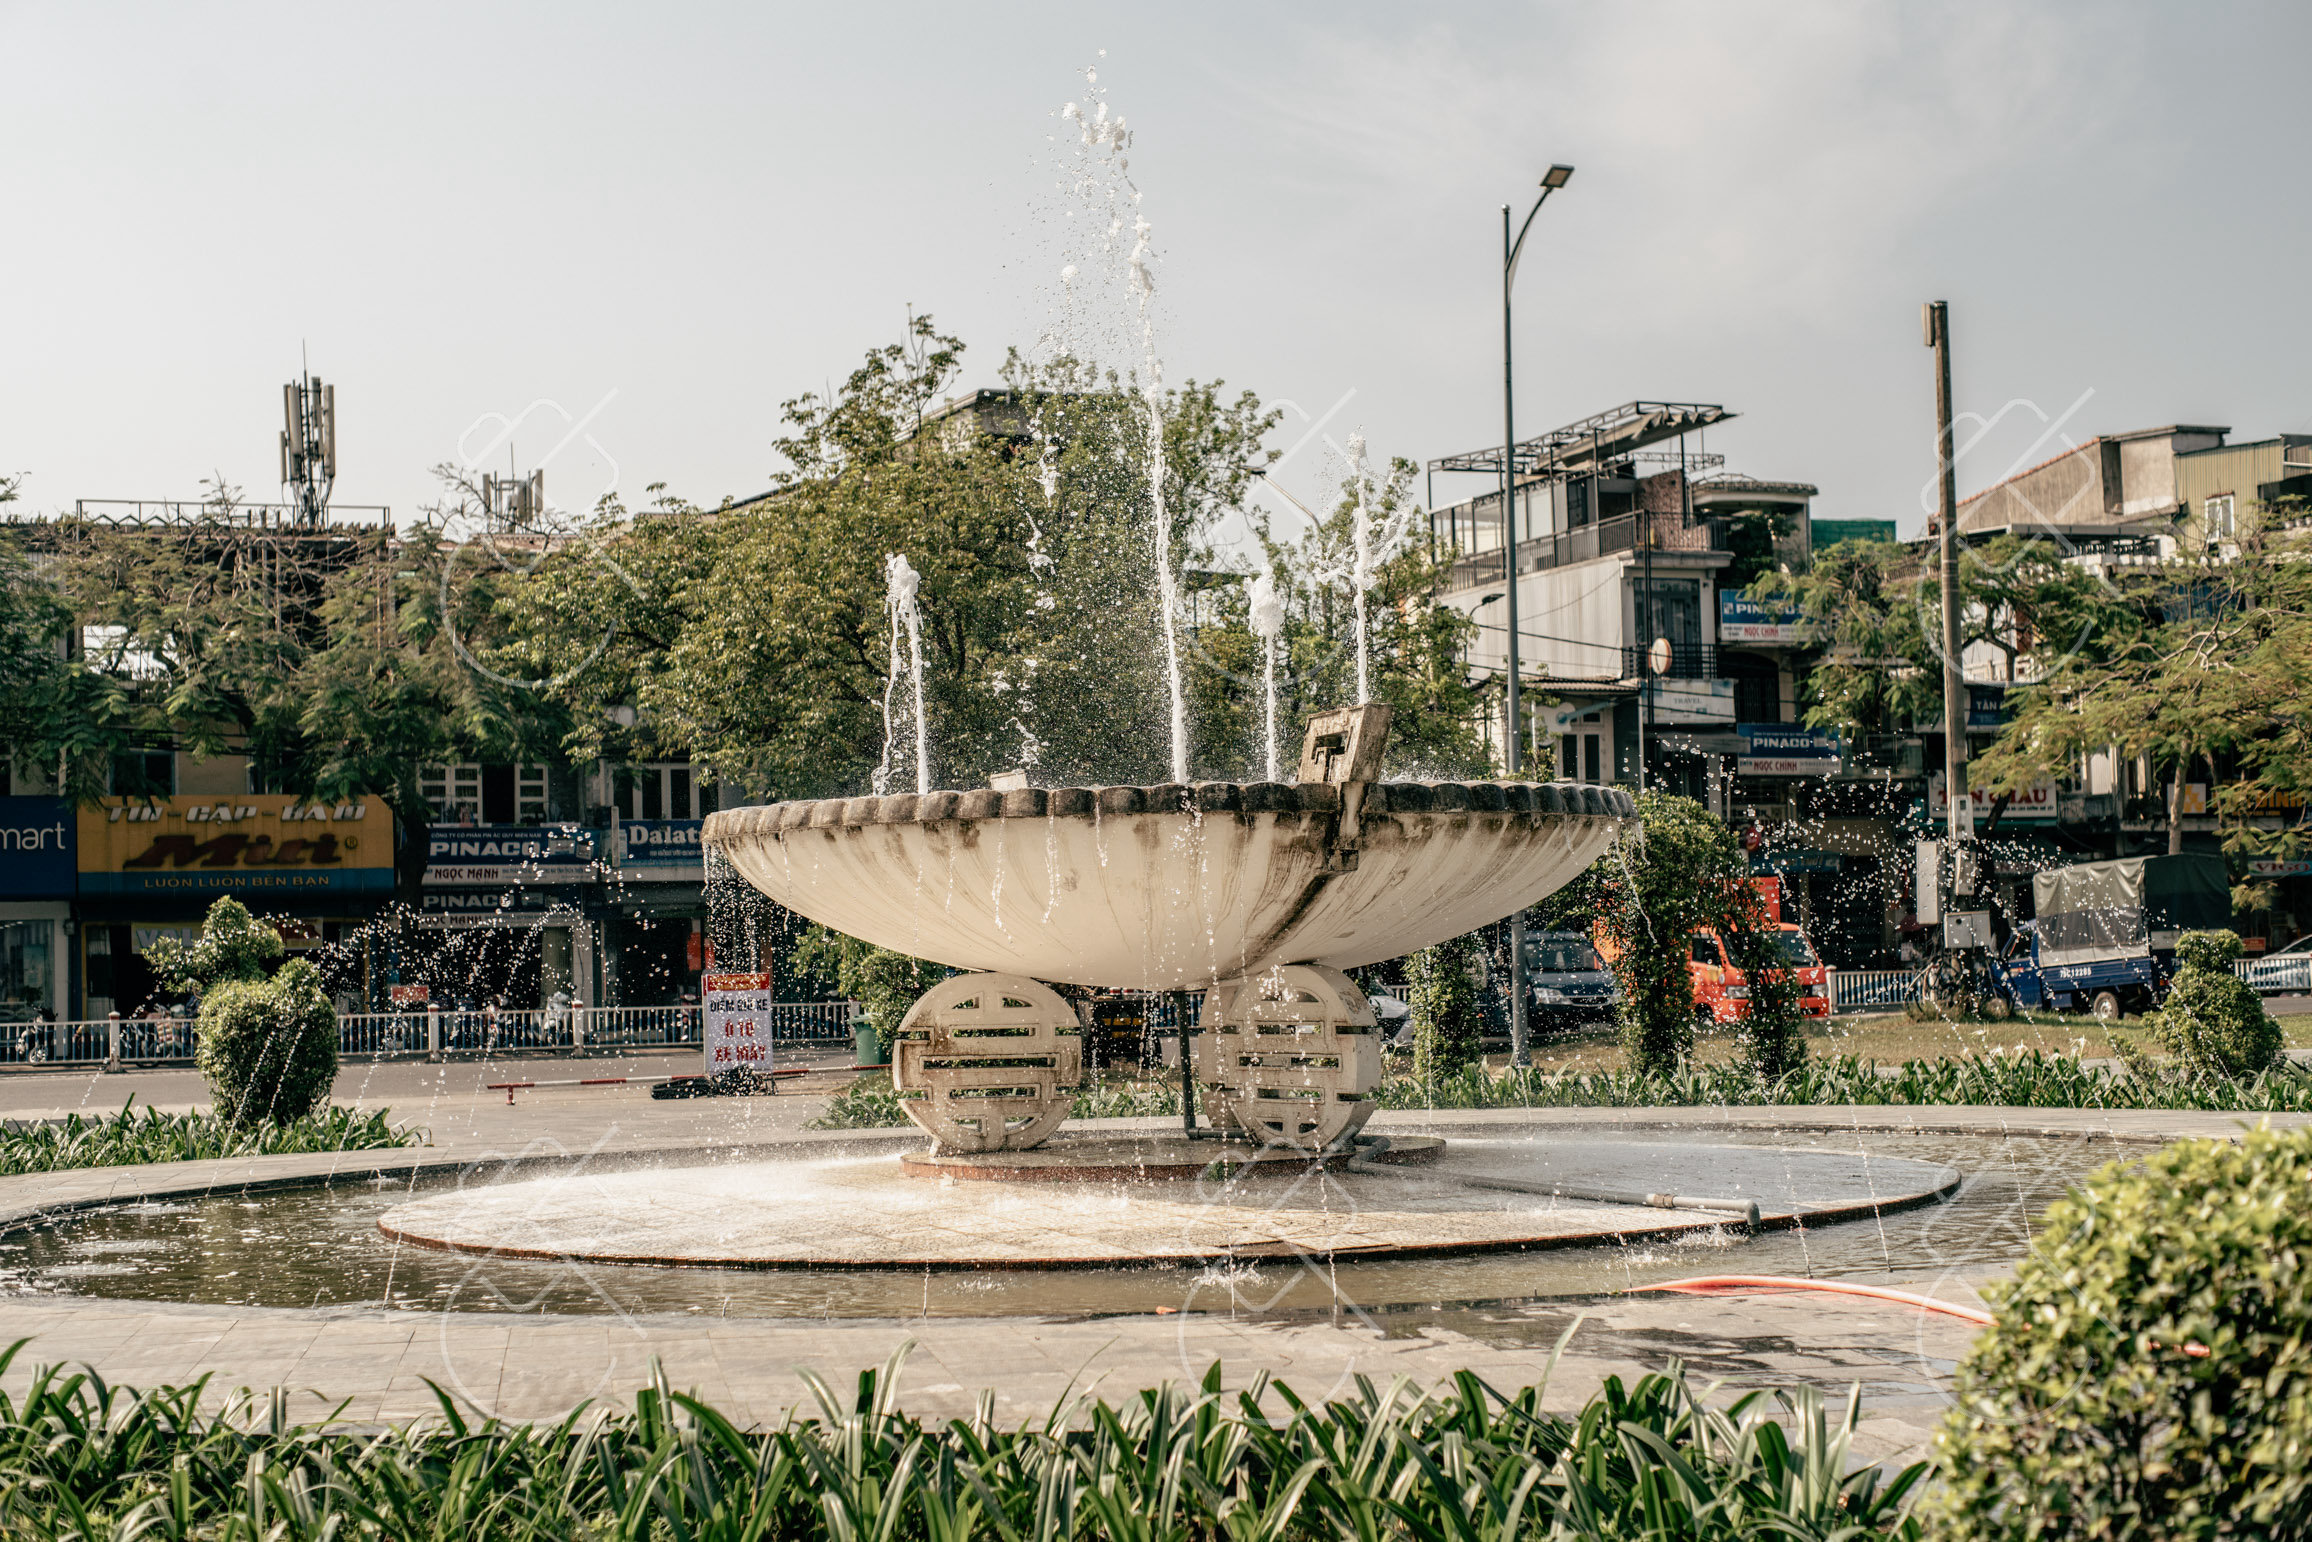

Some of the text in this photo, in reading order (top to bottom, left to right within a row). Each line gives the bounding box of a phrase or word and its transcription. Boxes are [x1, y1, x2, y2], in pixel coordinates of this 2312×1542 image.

[1753, 737, 1810, 748] PINACO
[629, 825, 703, 845] Dalat
[430, 841, 541, 857] PINACO
[144, 873, 329, 888] LUÔN LUÔN BÊN BẠN
[434, 867, 499, 882] NGỌC MẠNH
